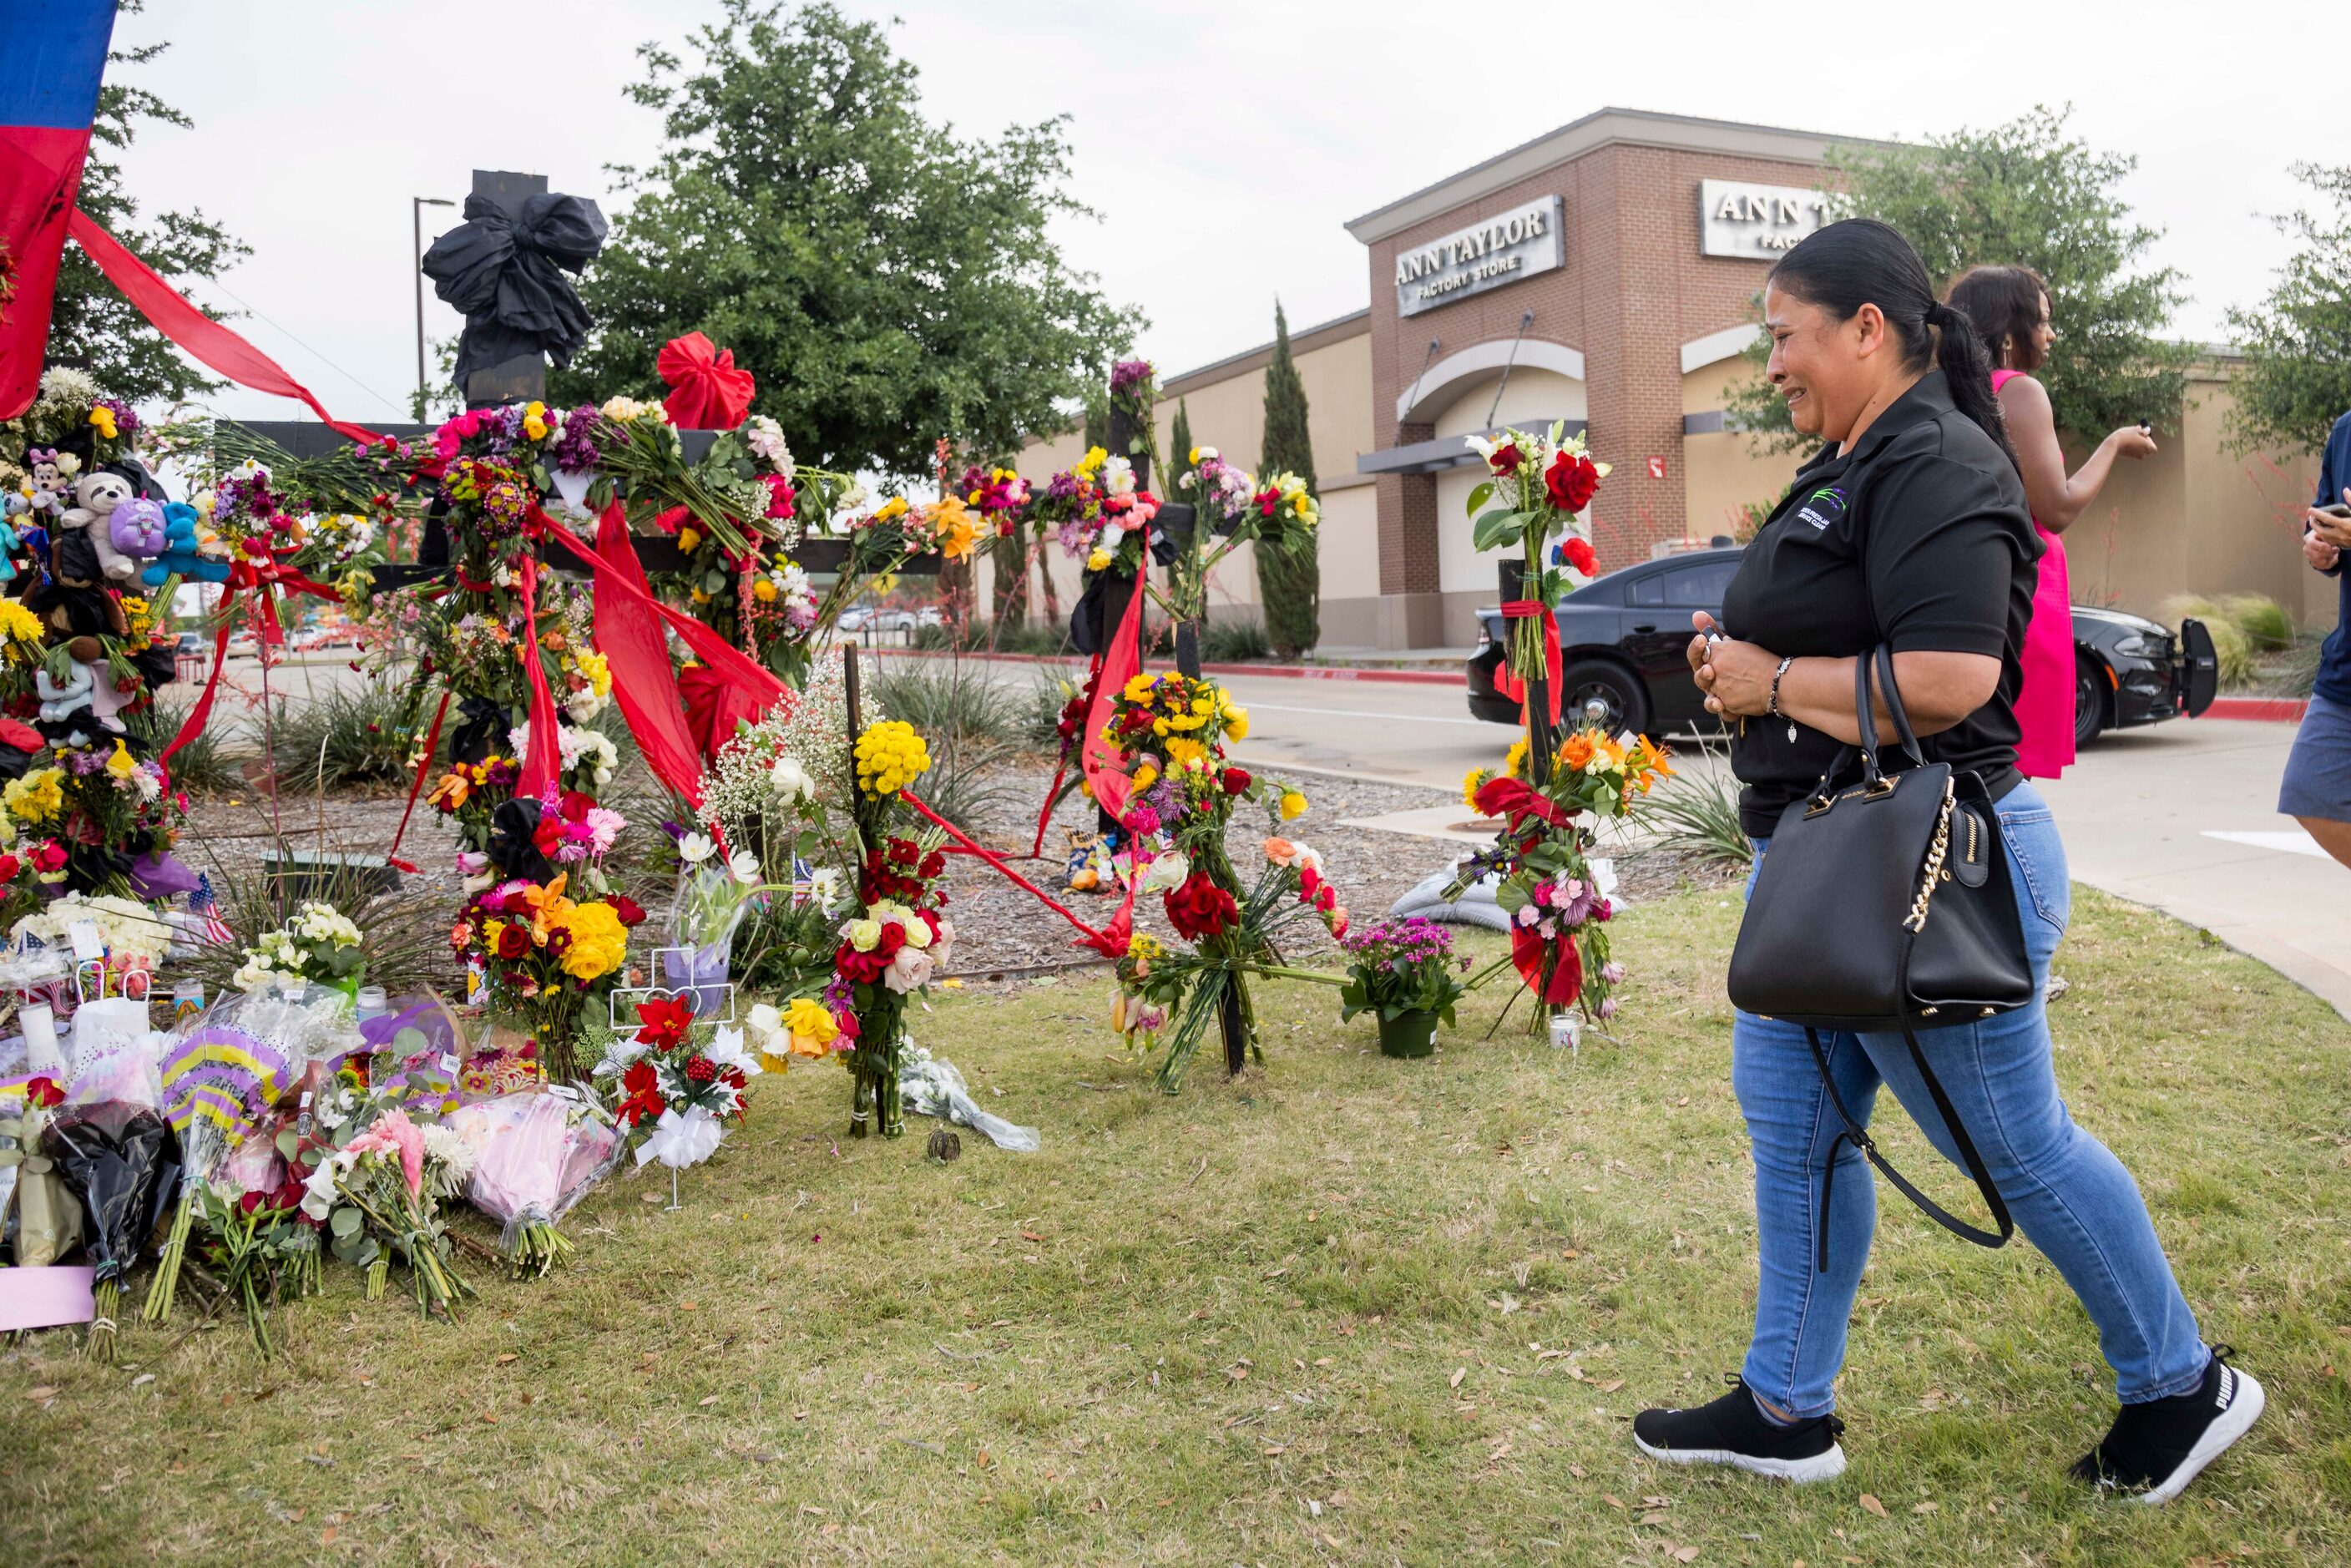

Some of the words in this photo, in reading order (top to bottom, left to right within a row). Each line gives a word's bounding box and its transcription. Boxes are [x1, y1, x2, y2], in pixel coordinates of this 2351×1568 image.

[1716, 193, 1800, 224] ANN
[1393, 248, 1441, 286] ANN
[1446, 210, 1545, 266] TAYLOR
[1418, 272, 1469, 300] FACTORY
[1473, 254, 1518, 281] STORE
